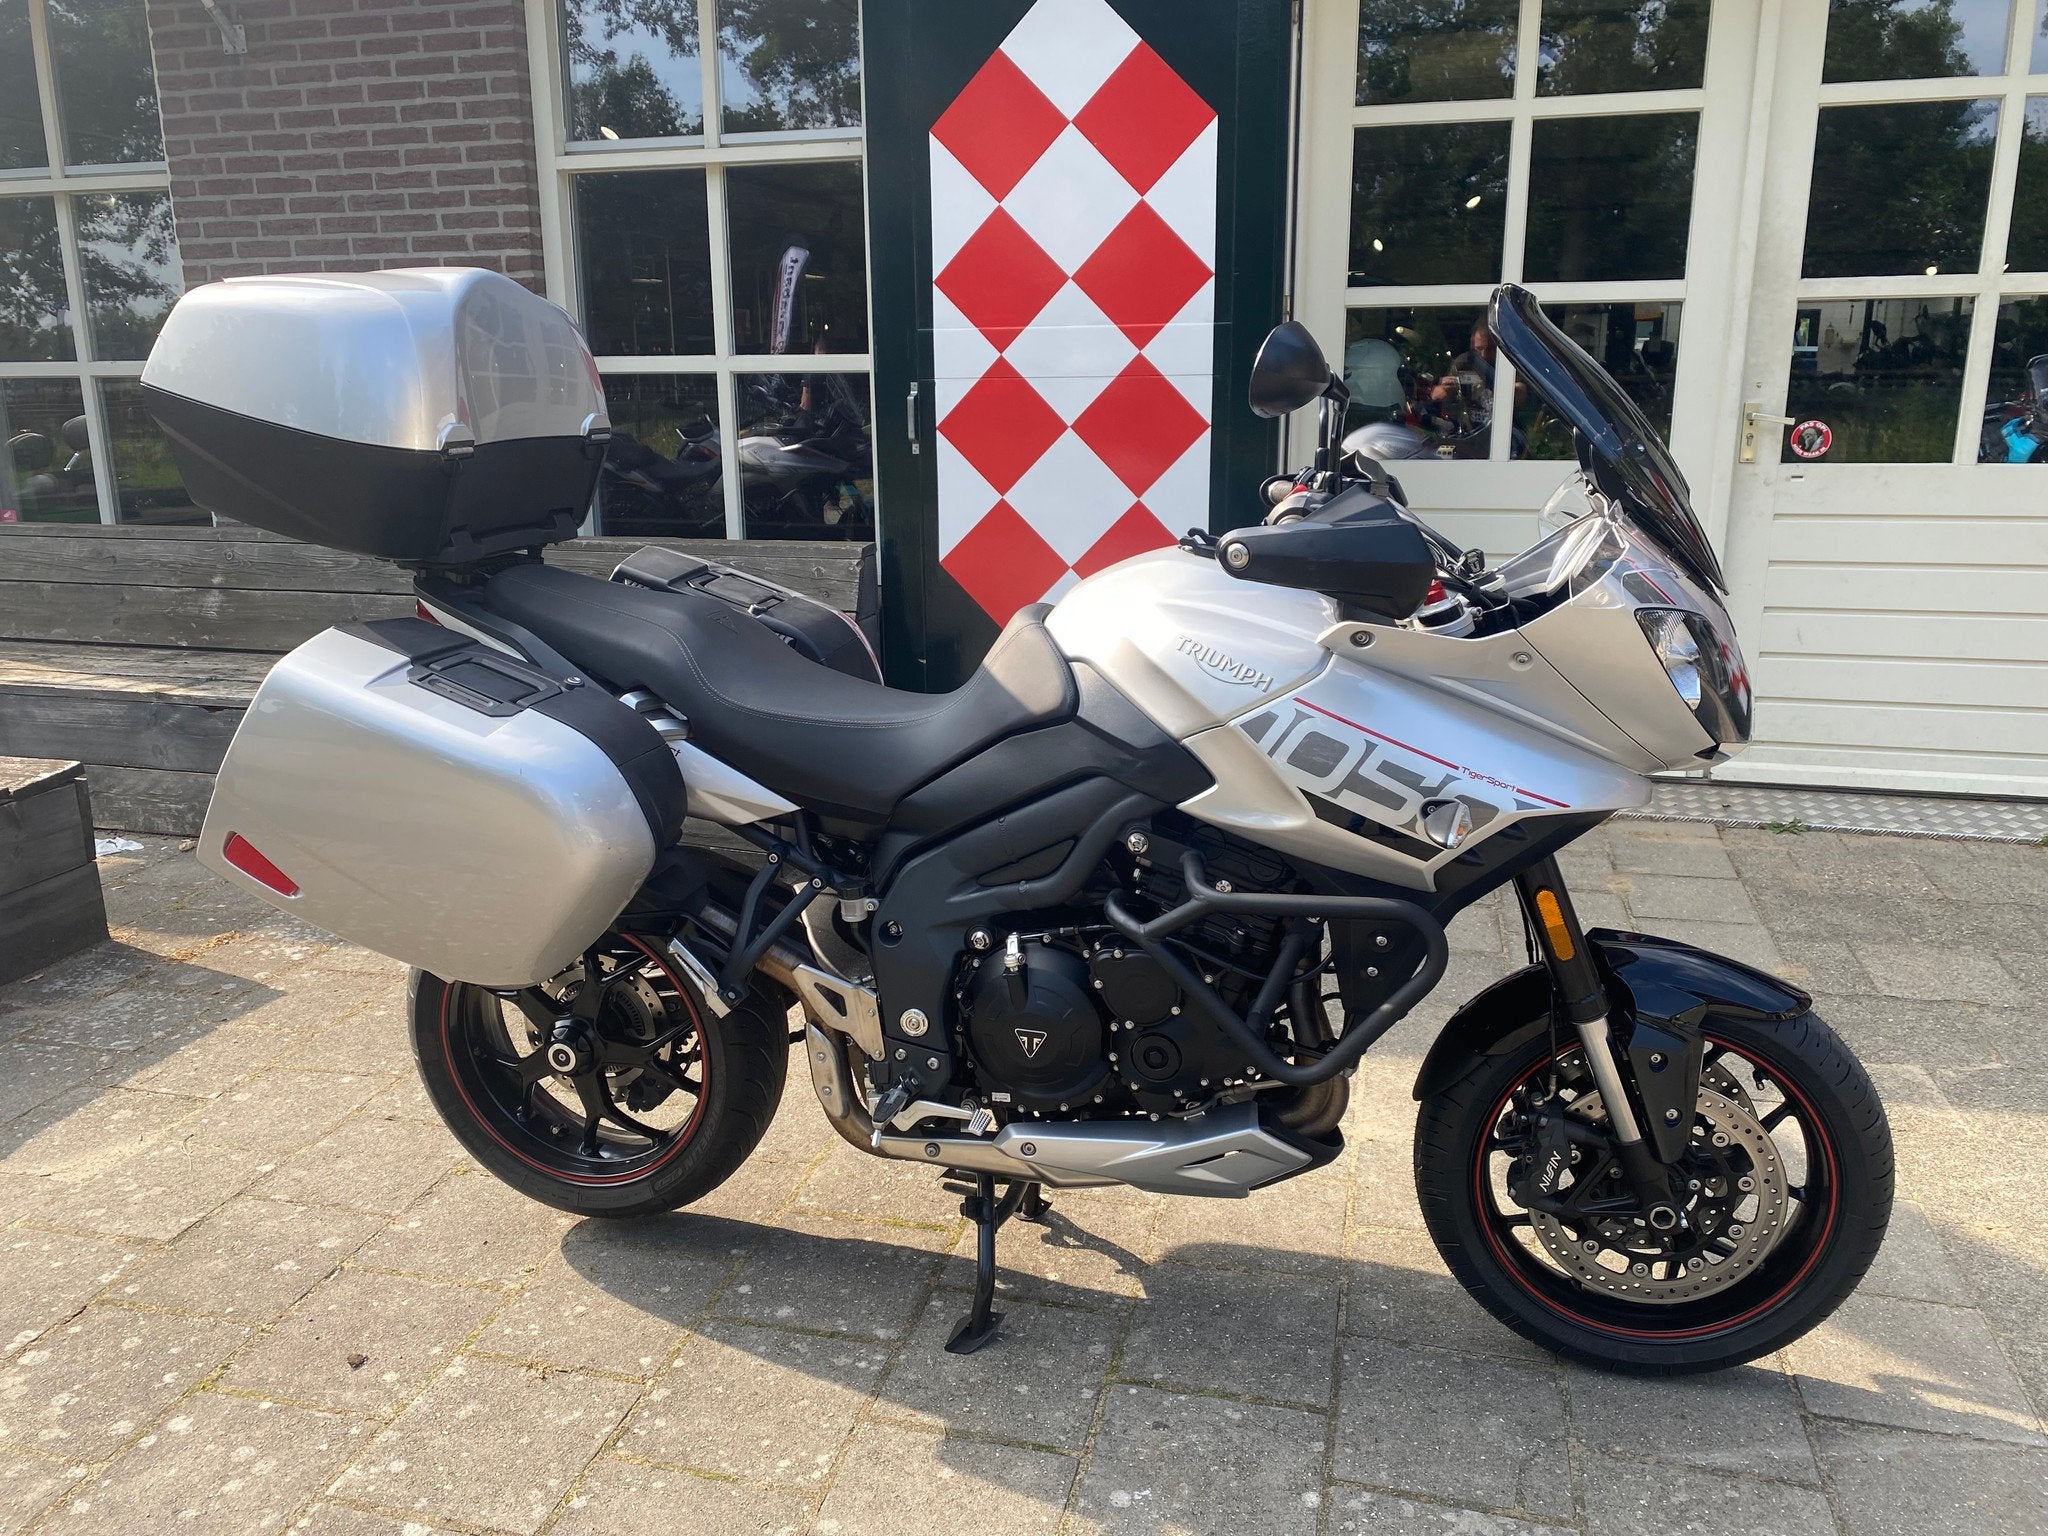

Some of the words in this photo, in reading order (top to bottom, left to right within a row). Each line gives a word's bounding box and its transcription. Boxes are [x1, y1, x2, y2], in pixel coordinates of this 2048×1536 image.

[1177, 634, 1274, 693] TRIUMPH
[1461, 766, 1517, 792] TigerSport
[1539, 1150, 1561, 1192] NISSIN
